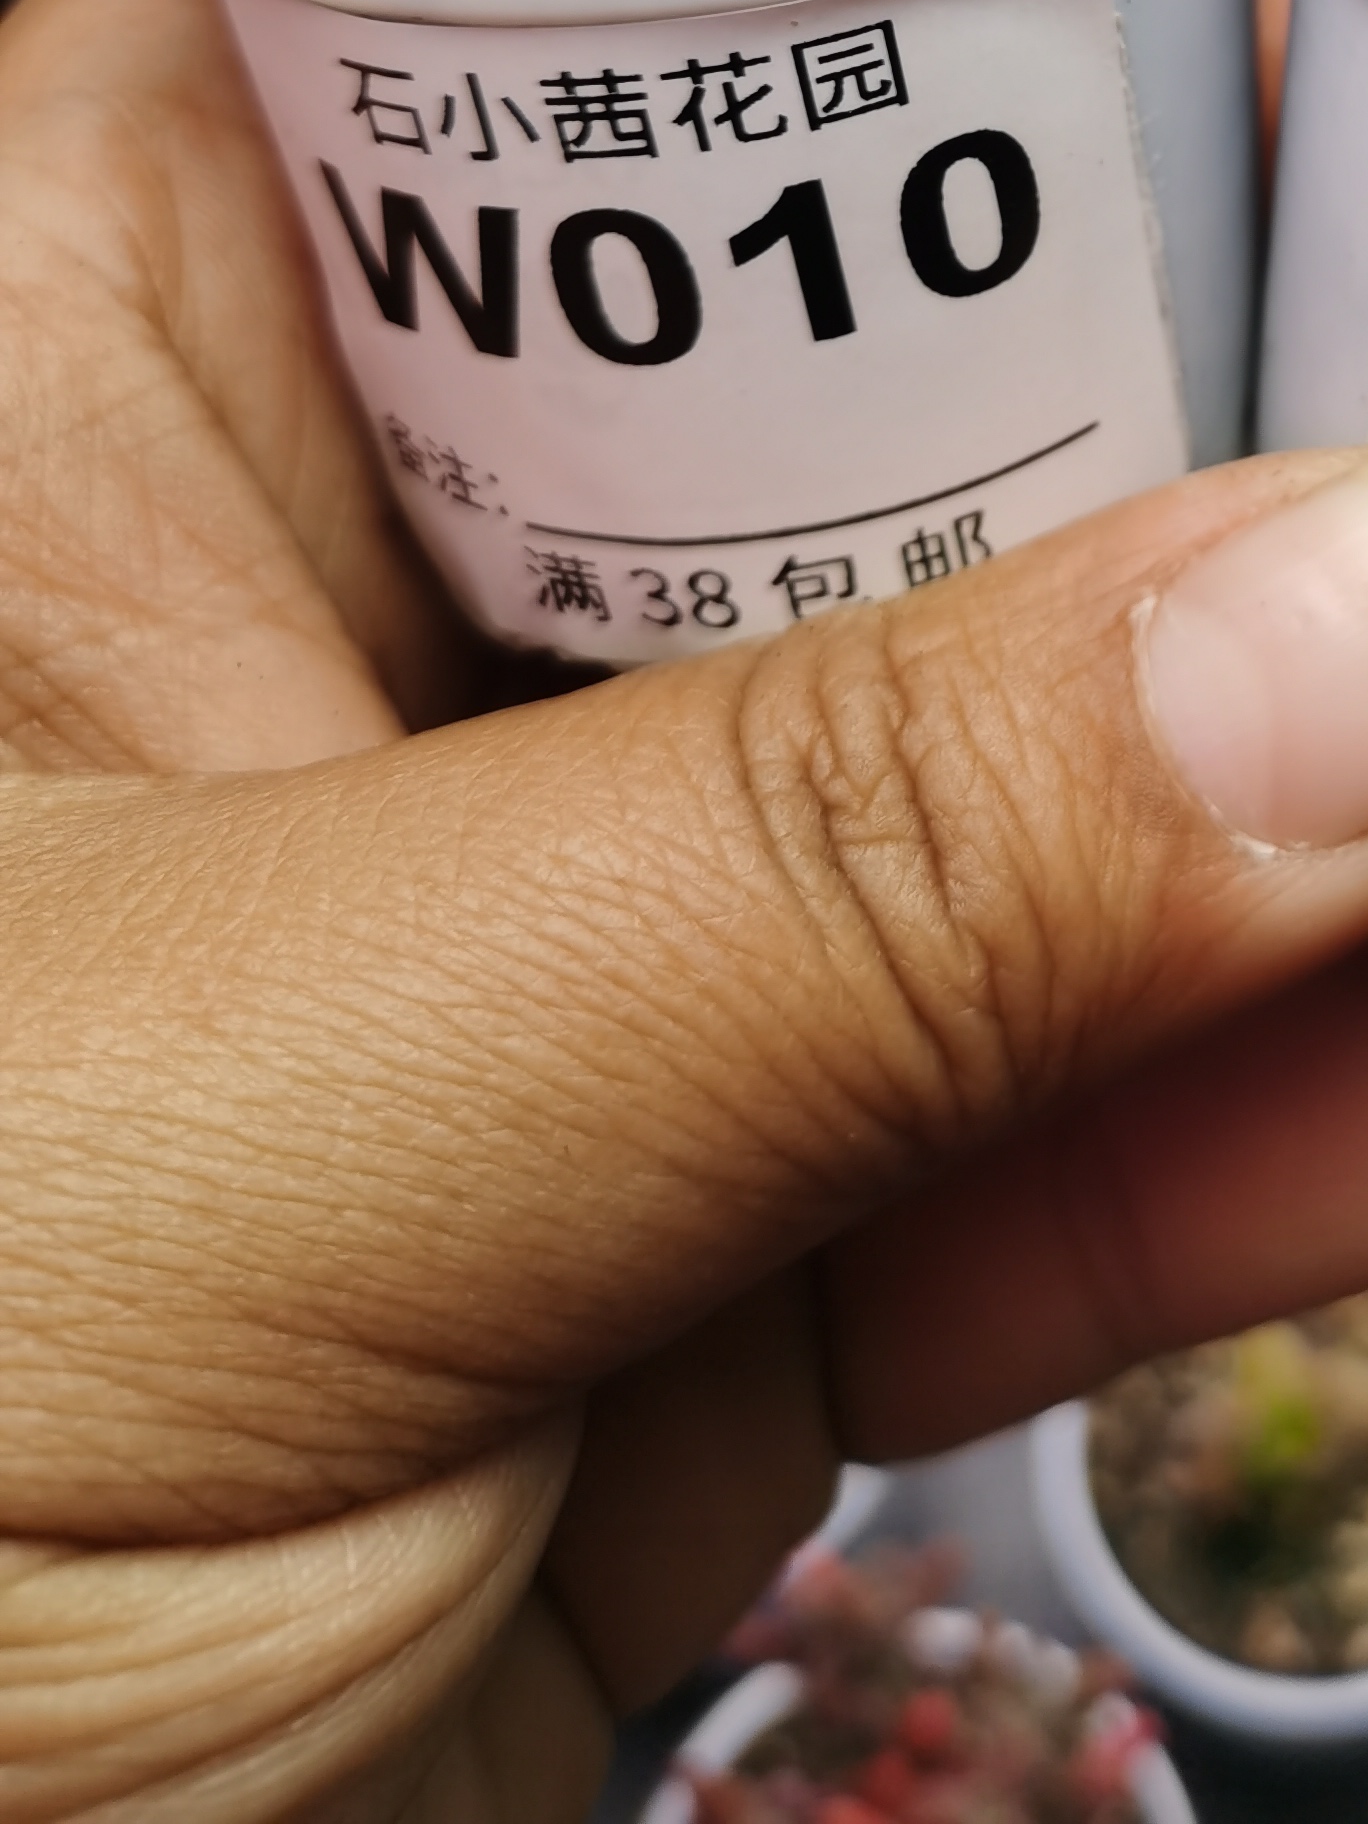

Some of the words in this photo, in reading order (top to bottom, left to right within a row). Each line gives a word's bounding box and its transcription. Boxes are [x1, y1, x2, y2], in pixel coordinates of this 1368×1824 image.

[338, 19, 910, 163] 石小茜花园
[318, 127, 1041, 367] W010
